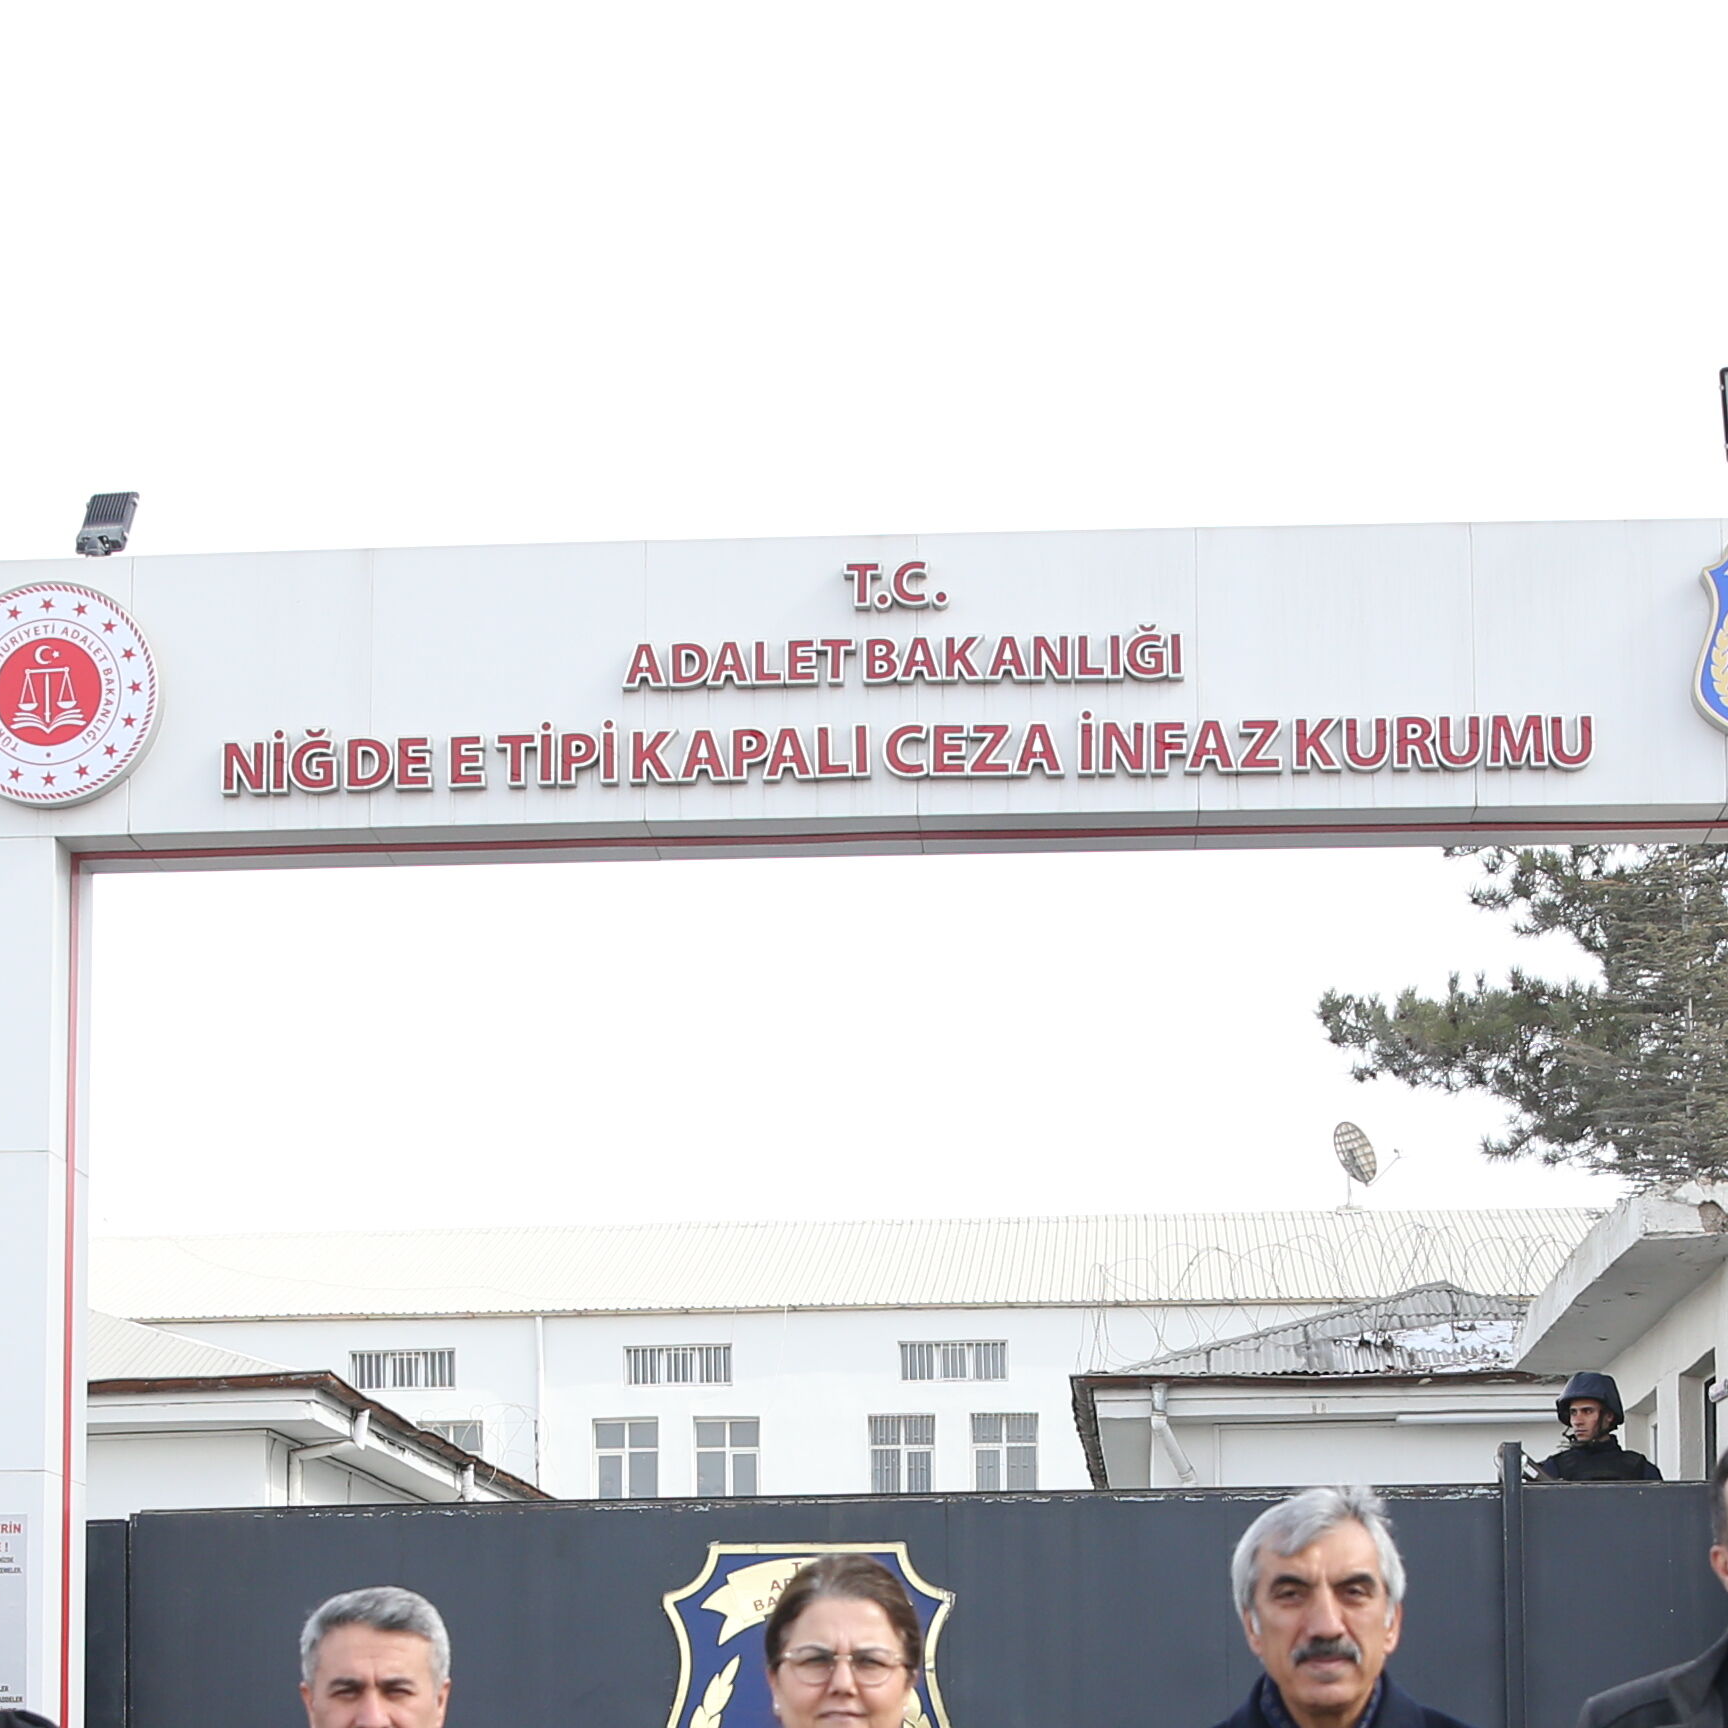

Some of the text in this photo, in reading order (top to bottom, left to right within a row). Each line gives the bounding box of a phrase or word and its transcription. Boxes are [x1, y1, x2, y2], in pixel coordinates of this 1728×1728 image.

[844, 560, 949, 611] T.C.
[61, 626, 109, 663] ADALET
[622, 623, 1185, 691] ADALET BAKANLIĞI
[221, 709, 1596, 796] NİĞDE E TİPİ KAPALI CEZA İNFAZ KURUMU
